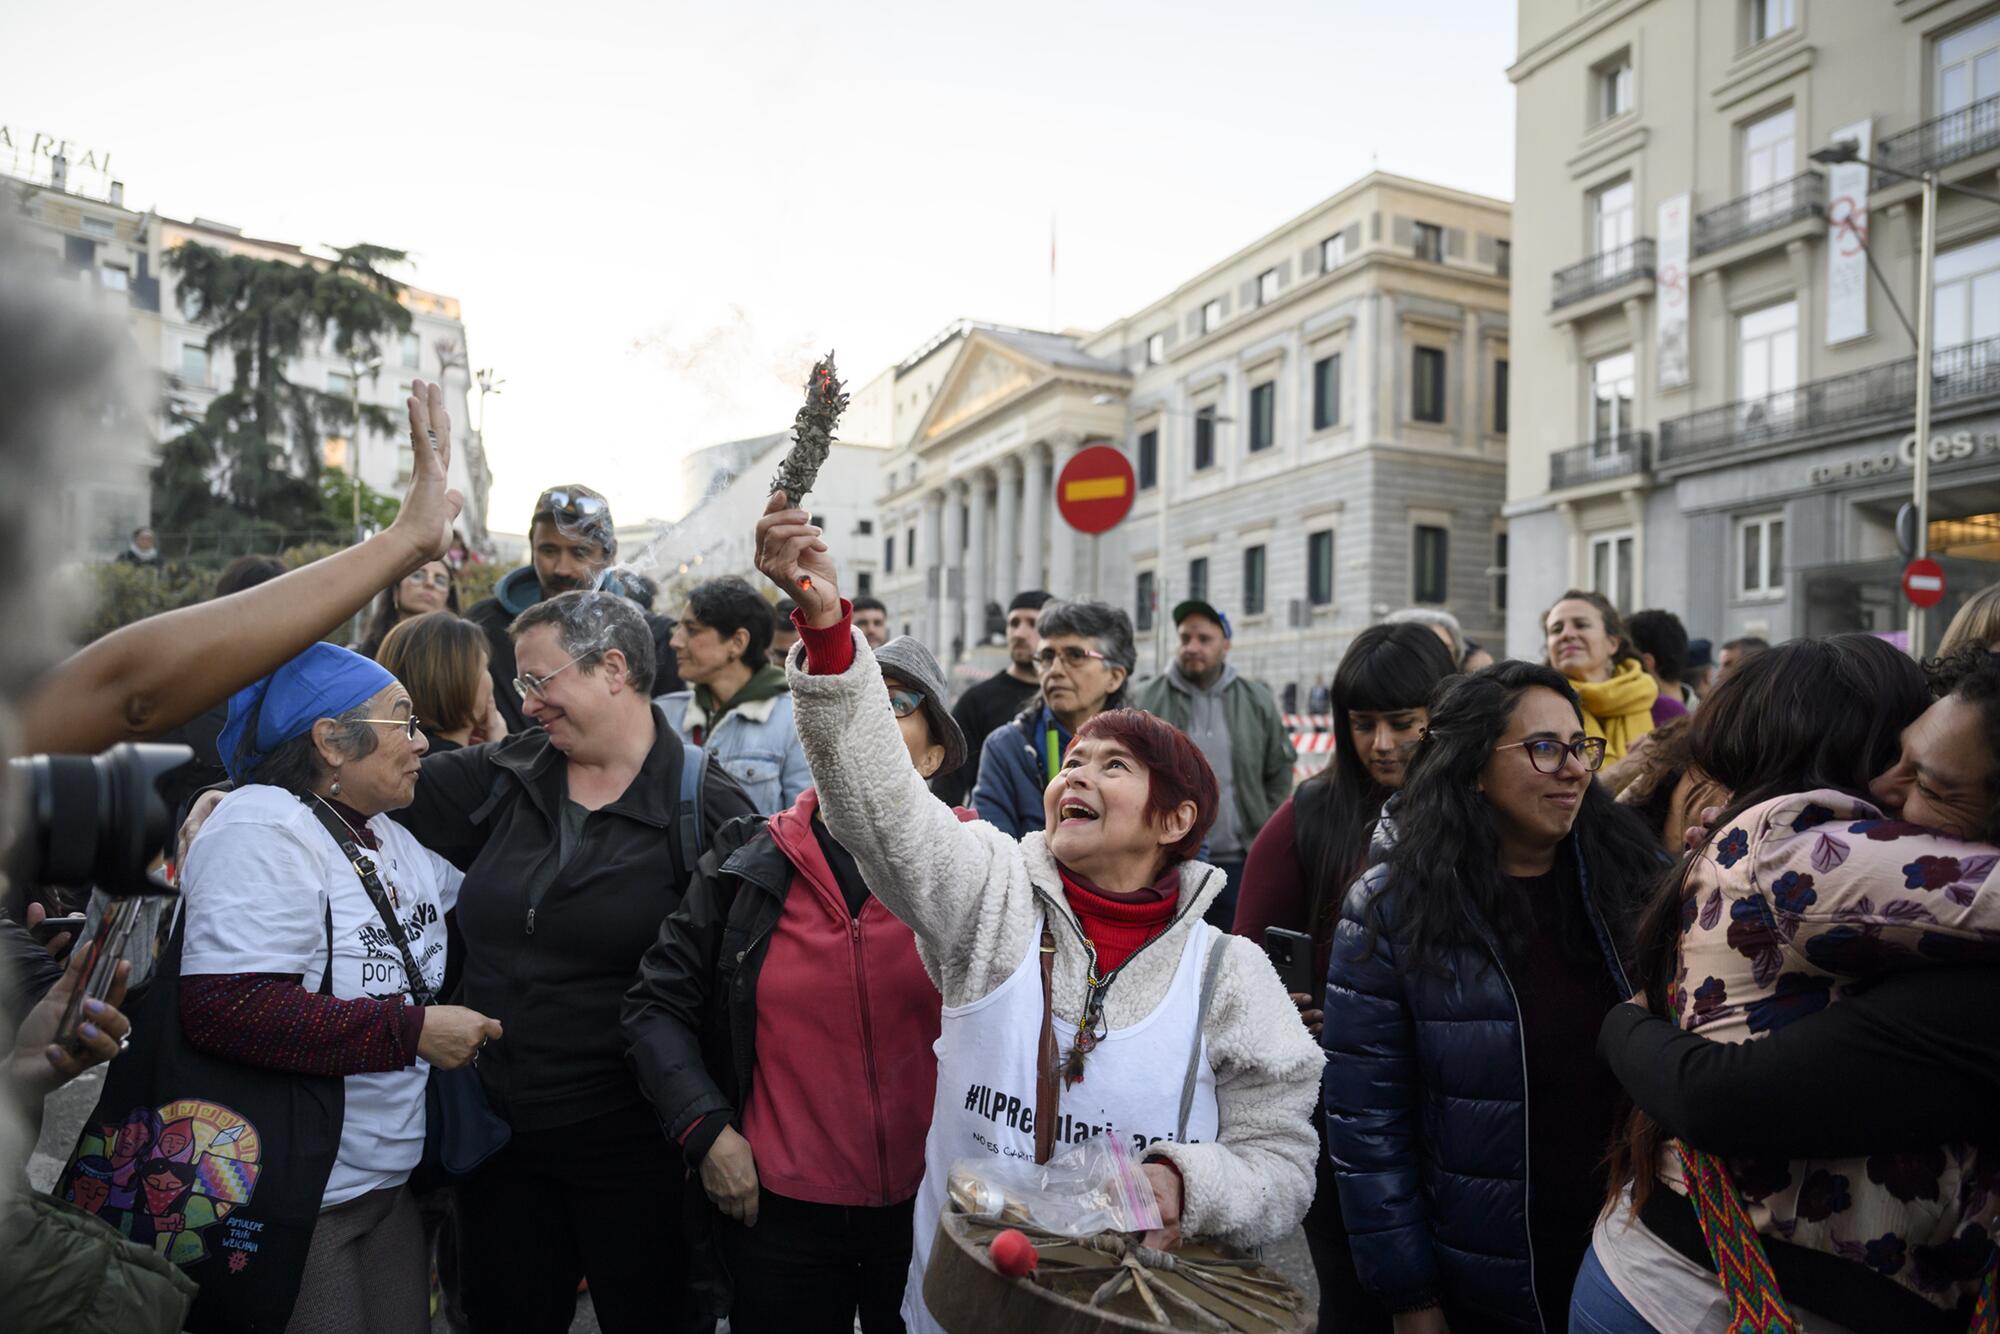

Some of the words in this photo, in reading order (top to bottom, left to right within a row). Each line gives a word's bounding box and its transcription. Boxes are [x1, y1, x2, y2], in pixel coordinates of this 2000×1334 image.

[362, 962, 394, 987] por
[972, 1131, 986, 1146] NO
[986, 1140, 999, 1154] ES
